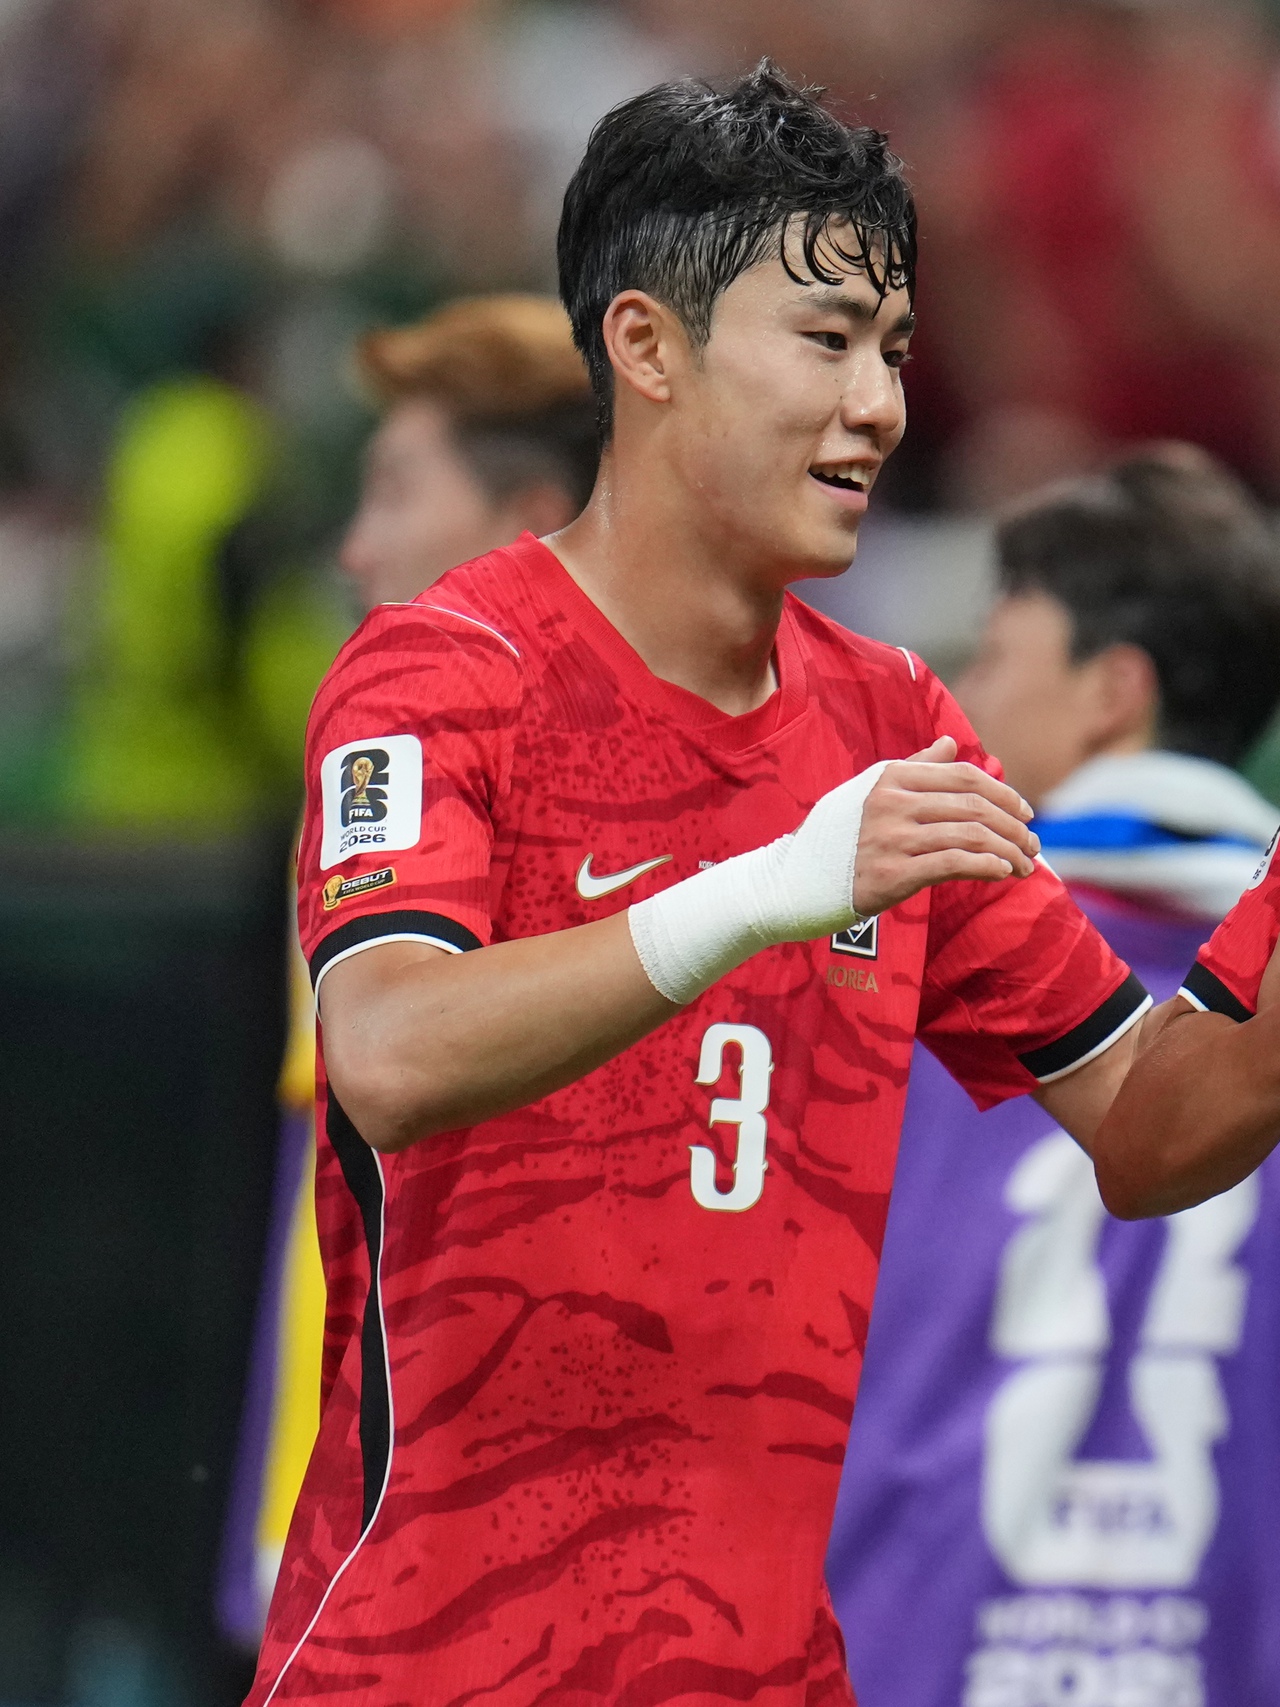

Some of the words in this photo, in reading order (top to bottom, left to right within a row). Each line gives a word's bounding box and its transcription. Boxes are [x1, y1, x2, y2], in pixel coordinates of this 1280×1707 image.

[349, 808, 374, 823] FIFA
[340, 826, 367, 841] WORLD
[339, 834, 386, 854] 2026
[341, 871, 389, 891] DEBUT
[826, 965, 879, 993] KOREA
[688, 1022, 774, 1212] 3
